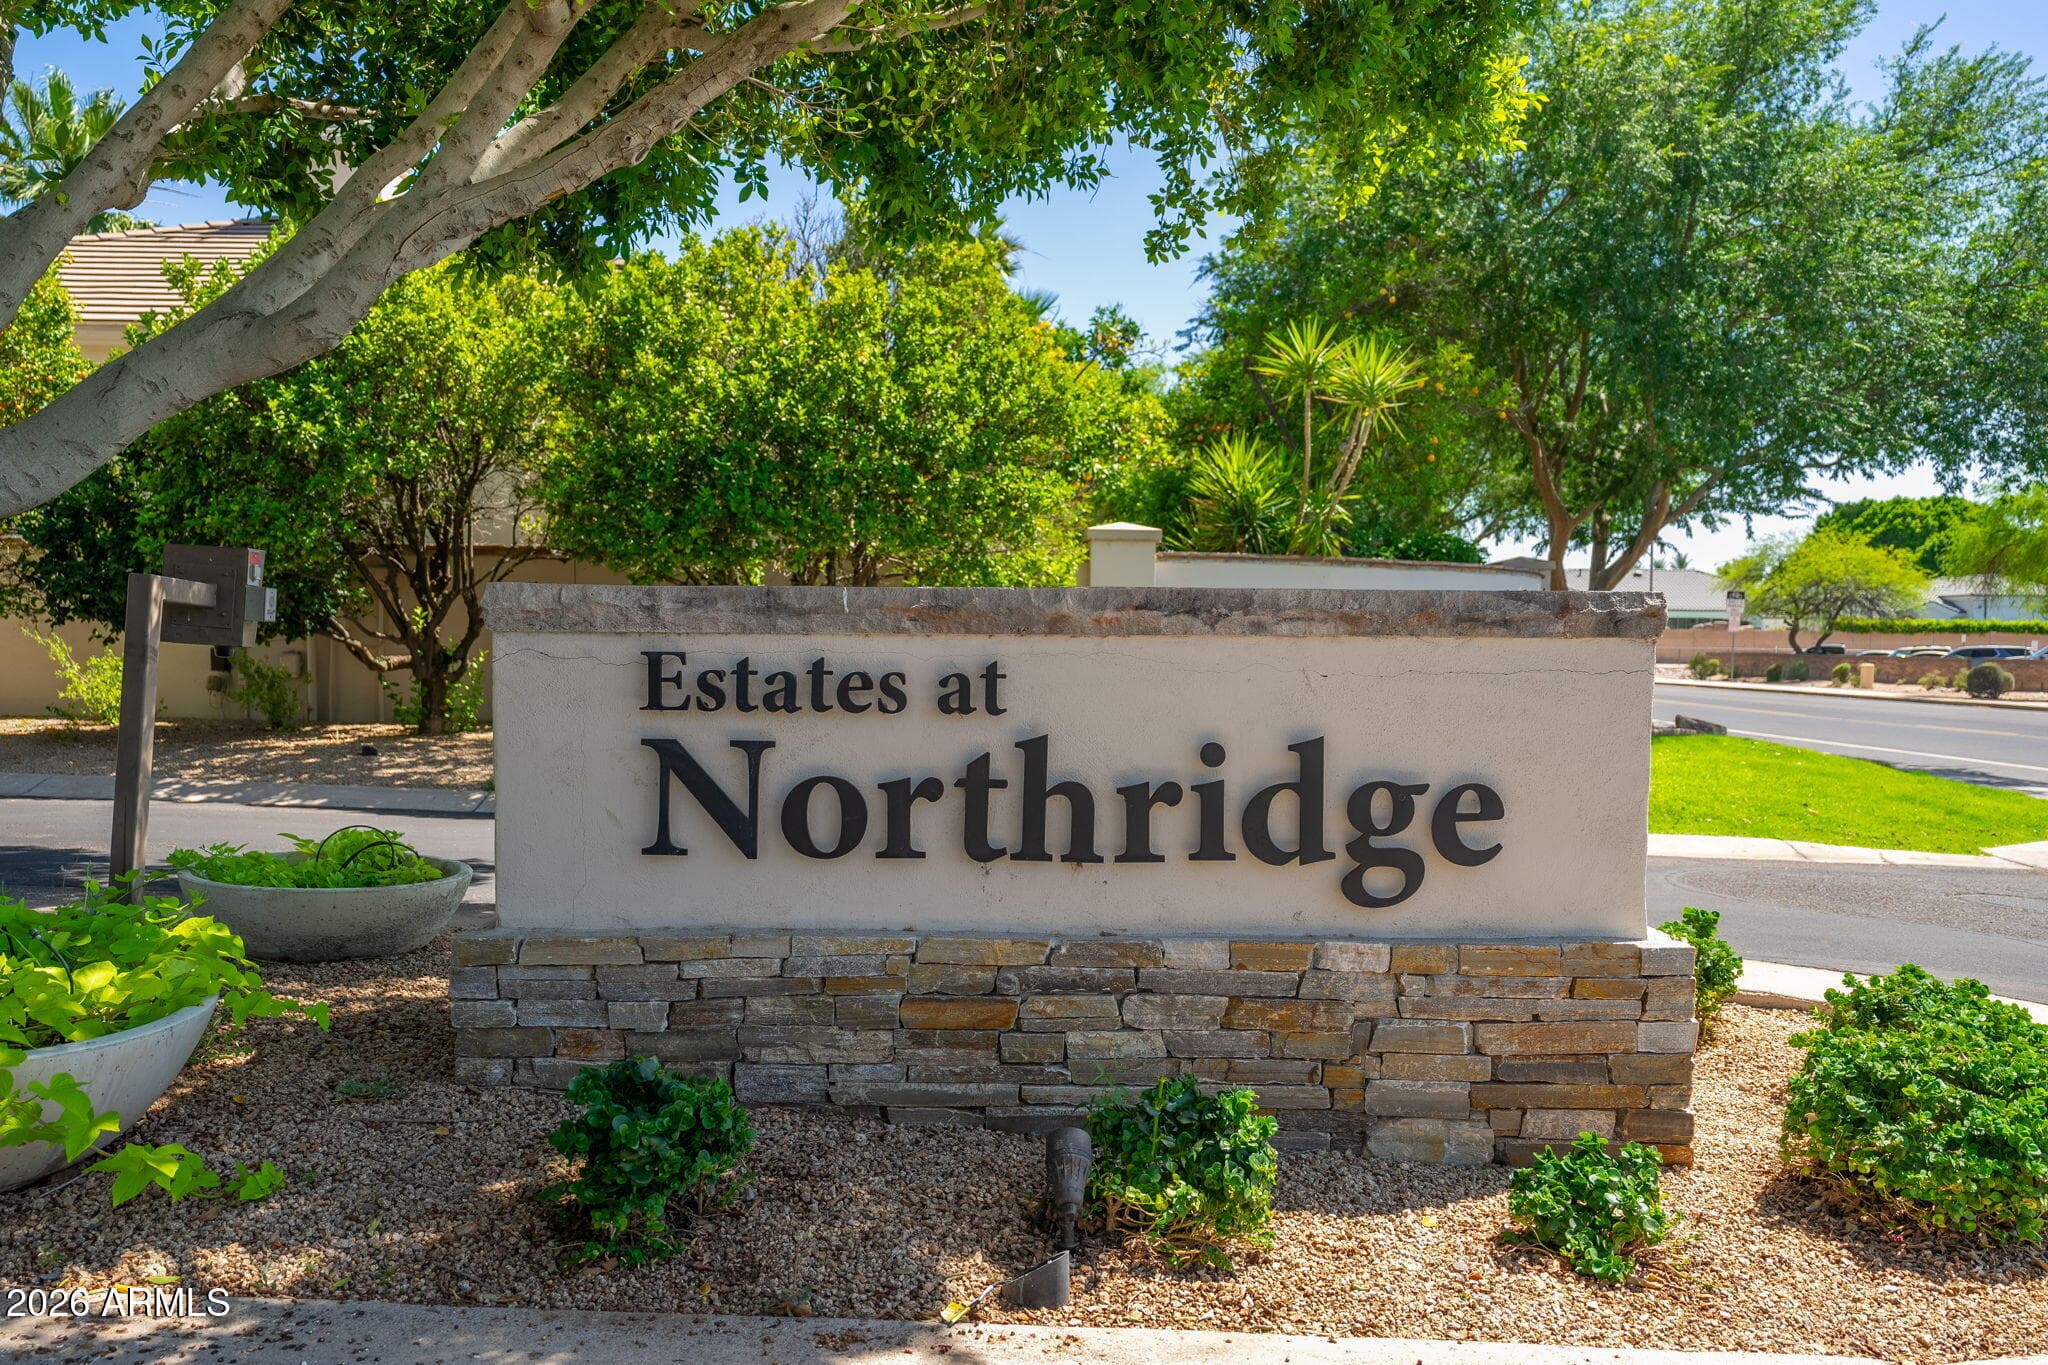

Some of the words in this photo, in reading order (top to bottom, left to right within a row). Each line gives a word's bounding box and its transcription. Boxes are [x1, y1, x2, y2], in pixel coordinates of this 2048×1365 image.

[639, 651, 908, 715] Estates
[937, 660, 1008, 717] at
[640, 734, 1505, 908] Northridge
